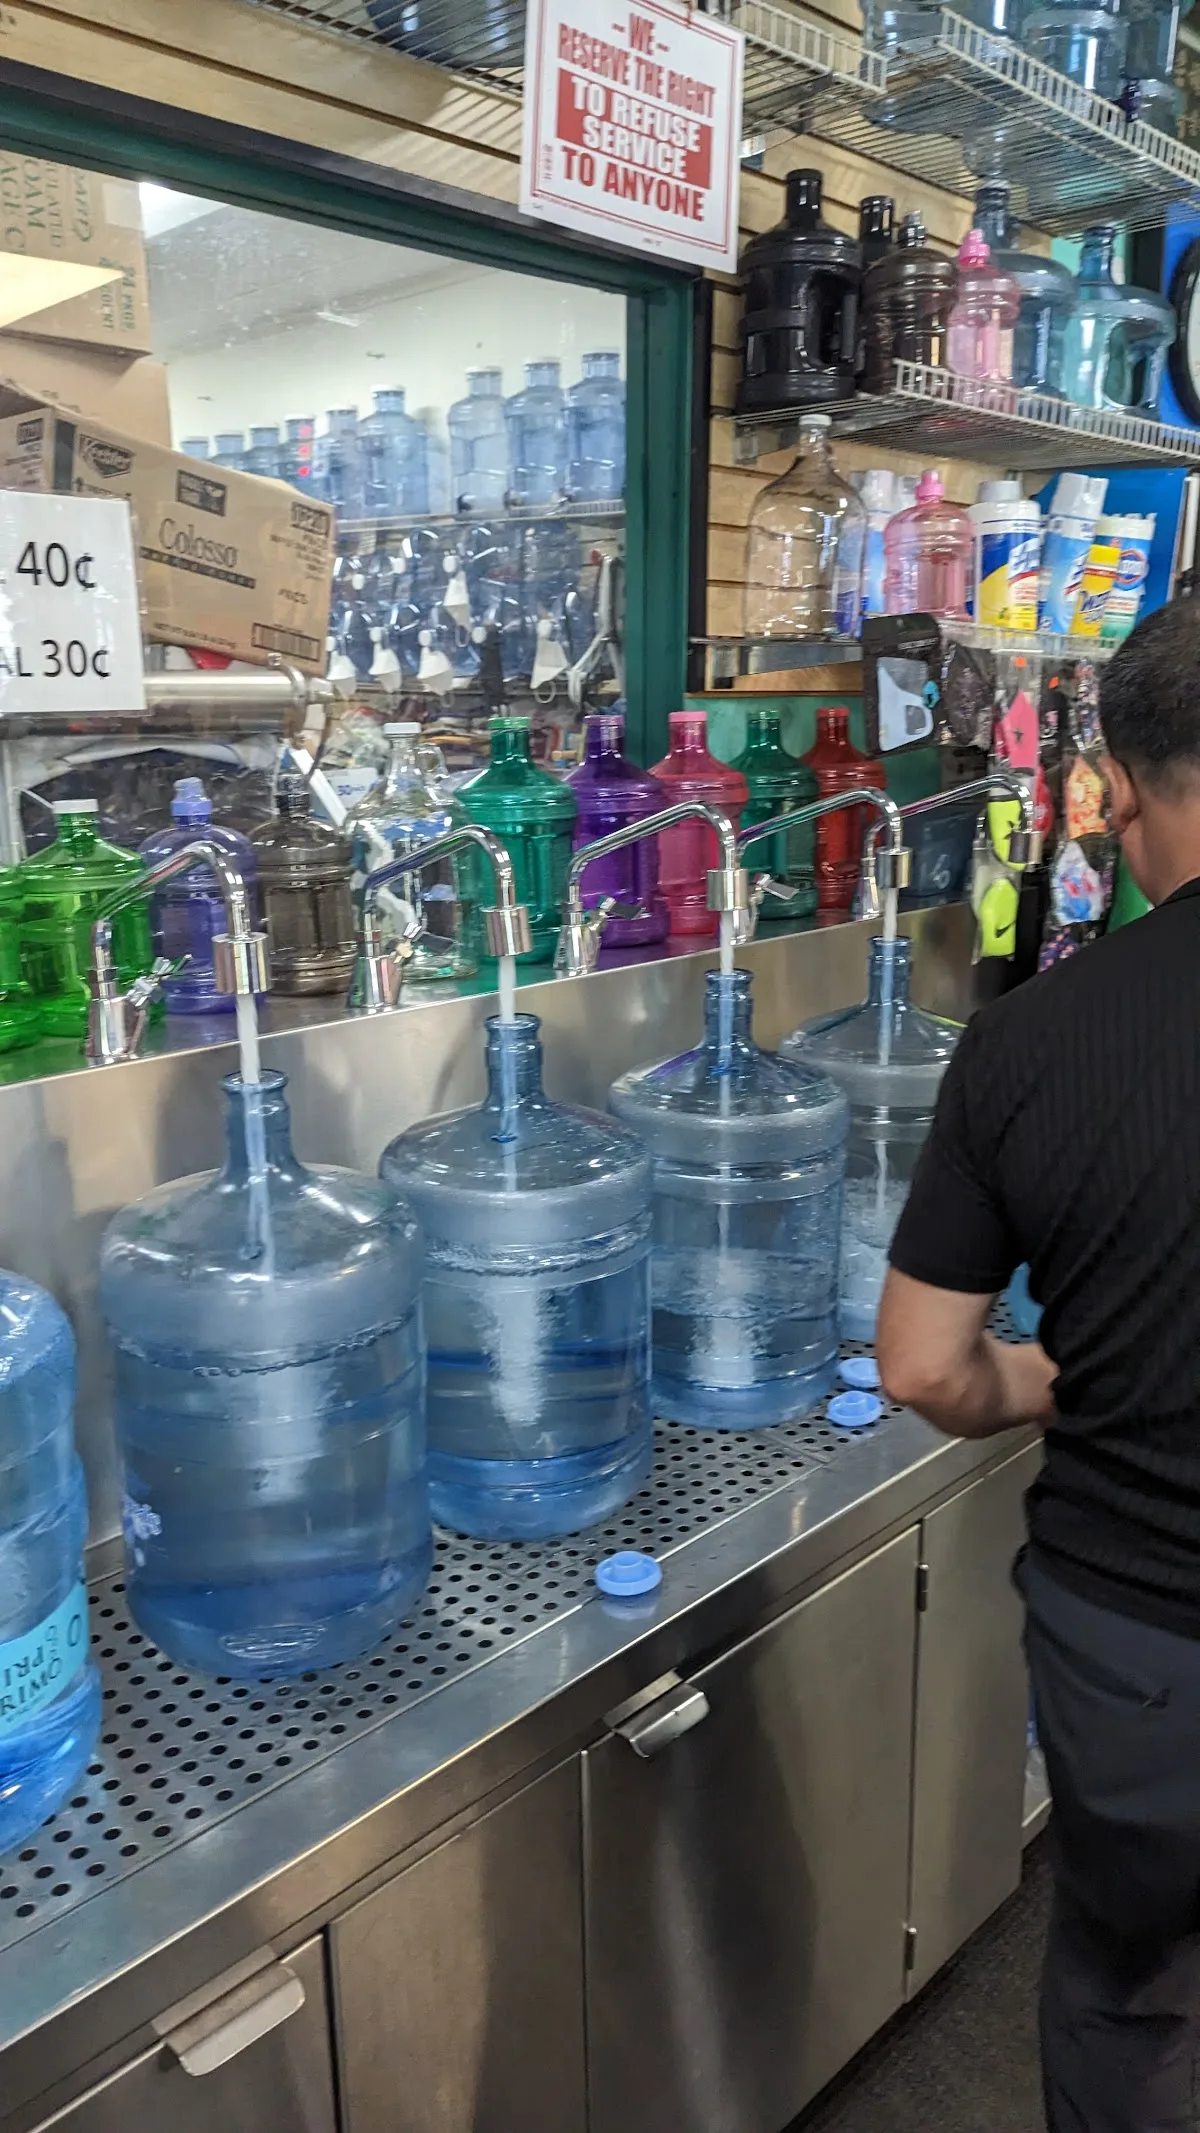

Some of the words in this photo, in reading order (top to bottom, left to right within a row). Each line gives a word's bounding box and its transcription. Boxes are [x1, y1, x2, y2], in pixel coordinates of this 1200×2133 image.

[558, 23, 630, 86] RESERVE
[633, 55, 664, 101] THE
[667, 69, 716, 119] RIGHT
[571, 75, 606, 116] TO
[611, 92, 701, 152] REFUSE
[582, 114, 687, 179] SERVICE
[21, 158, 47, 229] OAM
[561, 145, 595, 187] TO
[603, 161, 705, 222] ANYONE
[0, 646, 34, 677] AL
